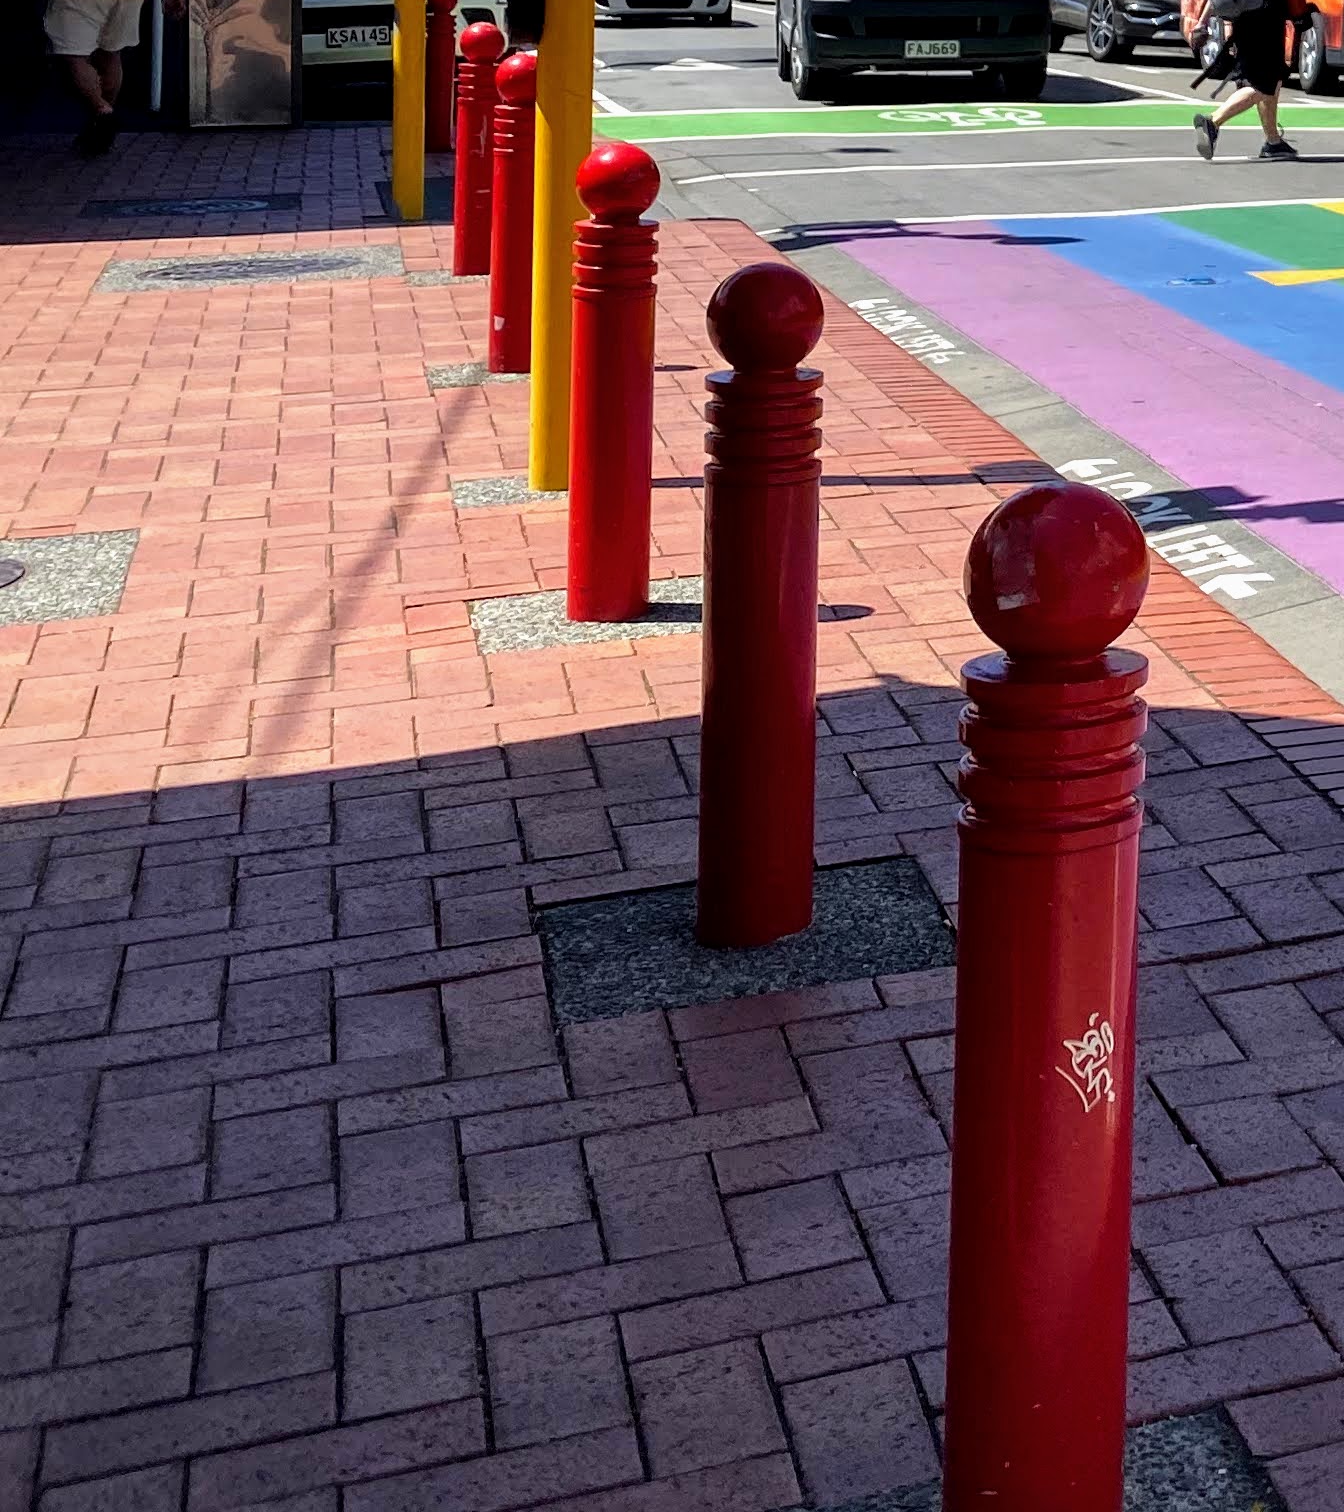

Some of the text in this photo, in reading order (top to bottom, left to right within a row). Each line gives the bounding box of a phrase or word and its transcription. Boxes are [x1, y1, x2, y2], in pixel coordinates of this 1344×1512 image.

[329, 28, 388, 43] KSA145
[907, 42, 957, 55] FAJ669
[1145, 524, 1254, 578] LEFT
